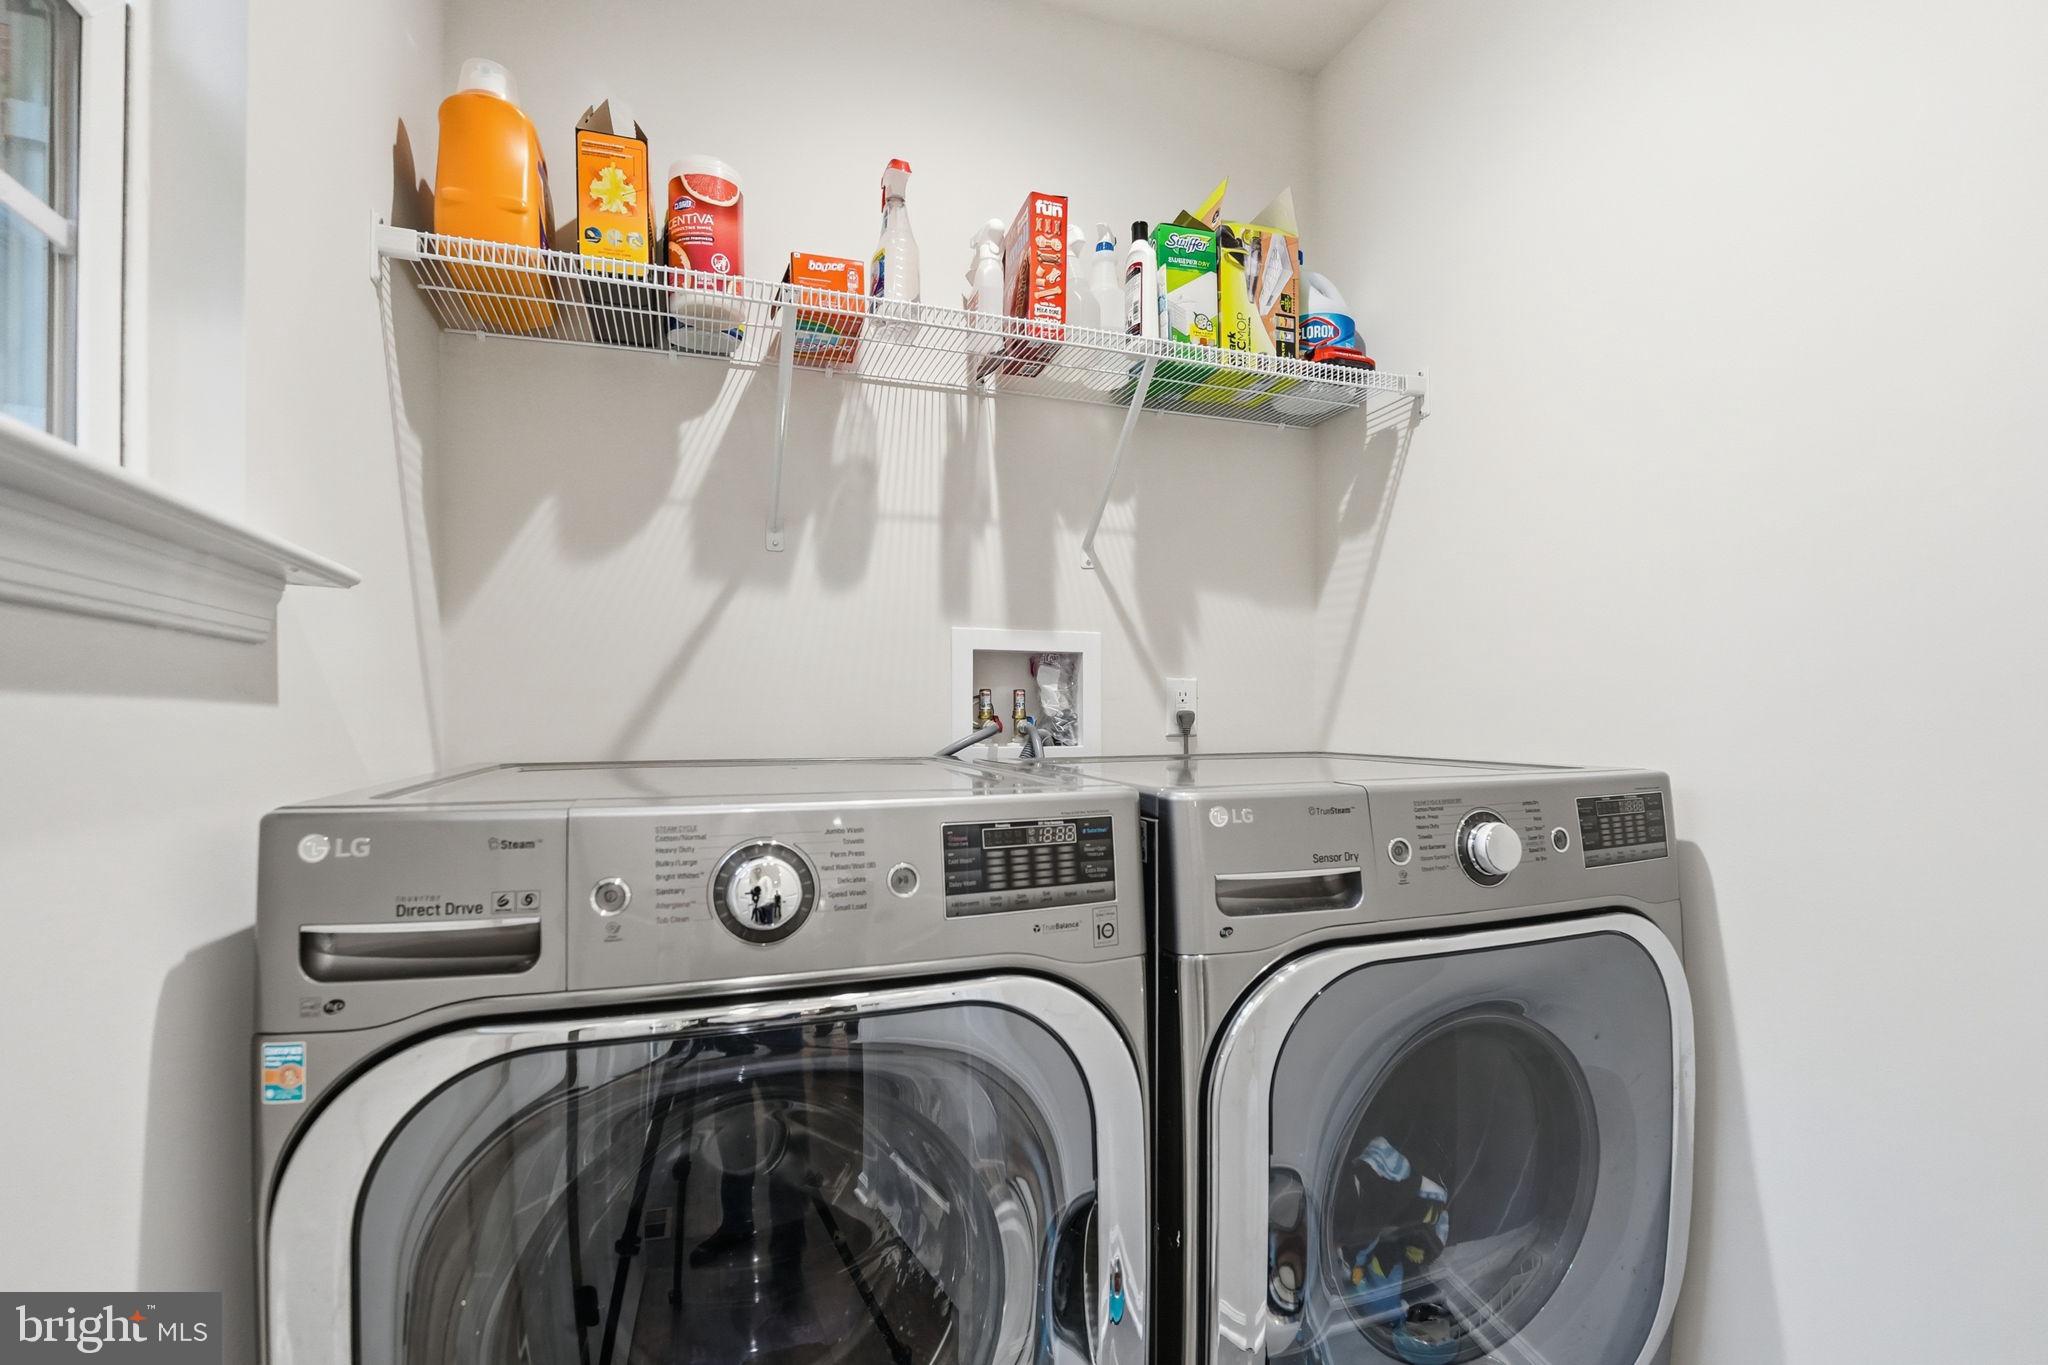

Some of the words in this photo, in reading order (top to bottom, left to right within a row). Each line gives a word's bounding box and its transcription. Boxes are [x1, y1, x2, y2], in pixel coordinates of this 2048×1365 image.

[669, 212, 714, 230] CENTIVA
[1165, 233, 1209, 253] Swiffer
[808, 260, 846, 272] bounce
[1300, 325, 1334, 339] LOROX
[1232, 808, 1254, 823] LG
[335, 837, 371, 857] LG
[1312, 853, 1342, 863] Sensor
[1344, 851, 1359, 862] Dry
[395, 903, 441, 918] Direct
[445, 901, 484, 916] Drive
[1097, 922, 1115, 940] 10
